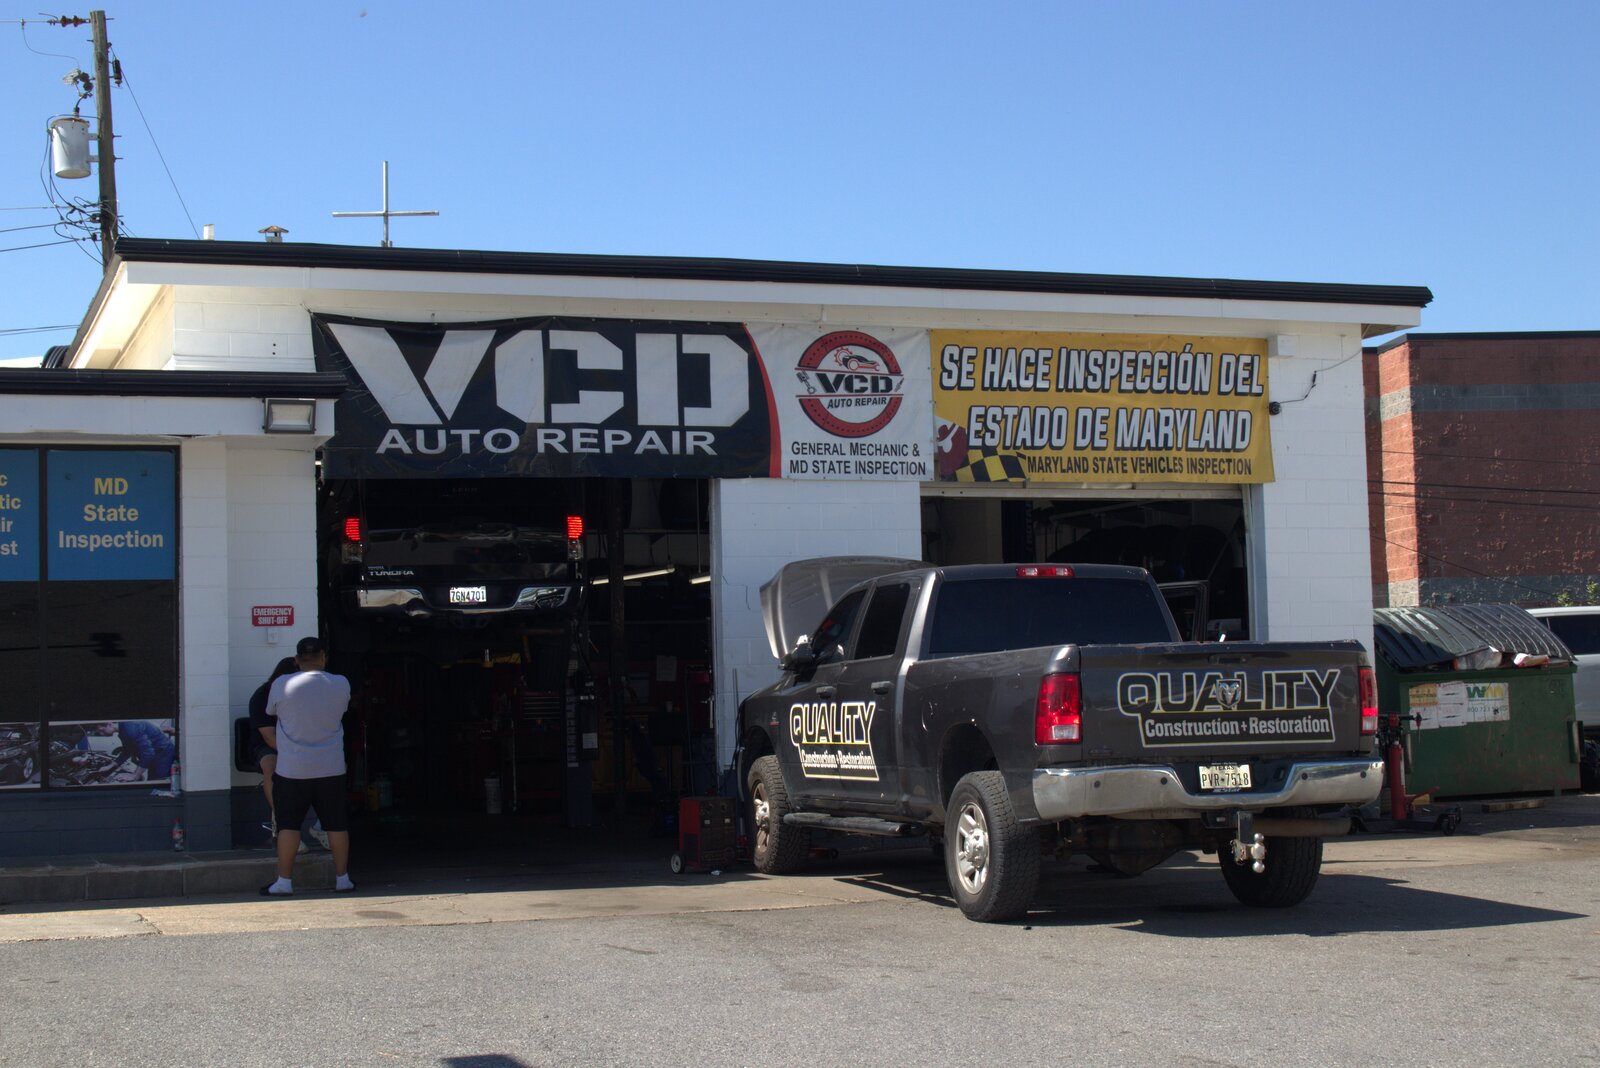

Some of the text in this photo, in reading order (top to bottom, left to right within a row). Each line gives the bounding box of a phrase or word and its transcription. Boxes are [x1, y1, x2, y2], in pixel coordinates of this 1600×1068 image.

[327, 323, 750, 427] VCD
[940, 343, 1264, 396] SE HACE INSPECCIÓN DEL
[815, 372, 893, 393] VCD
[827, 396, 887, 409] AUTO REPAIR
[967, 405, 1253, 452] ESTADO DE MARYLAND
[375, 428, 718, 455] AUTO REPAIR
[791, 441, 920, 457] GENERAL MECHANIC &
[790, 459, 926, 475] MD STATE INSPECTION
[1027, 455, 1252, 476] MARYLAND STATE VEHICLES INSPECTION
[94, 477, 129, 496] MD
[83, 503, 139, 522] State
[58, 530, 164, 552] Inspection
[253, 607, 292, 616] EMERGENCY
[790, 701, 876, 746] QUALITY
[1145, 717, 1240, 738] Construction
[1249, 715, 1330, 735] Restoration
